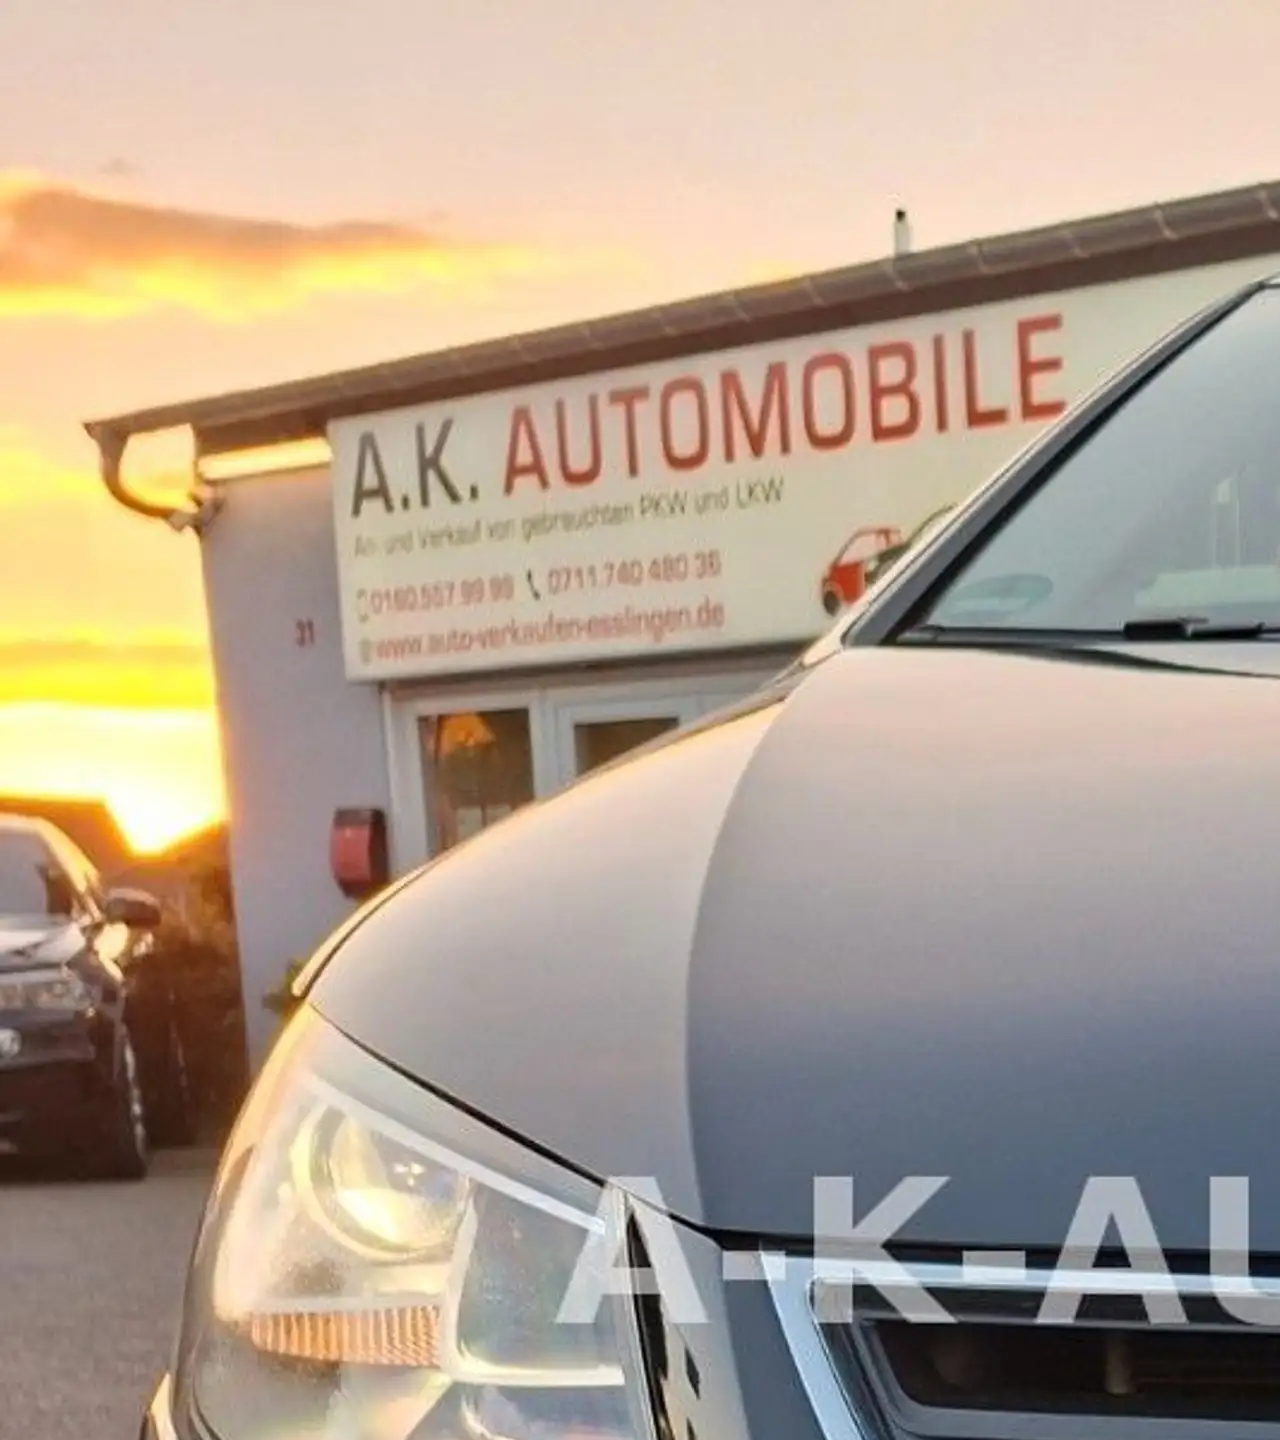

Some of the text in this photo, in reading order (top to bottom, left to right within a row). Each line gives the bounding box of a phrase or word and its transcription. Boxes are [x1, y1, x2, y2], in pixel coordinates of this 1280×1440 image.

[351, 313, 1070, 518] A.K. AUTOMOBILE
[639, 489, 688, 519] PKW
[694, 485, 730, 517] und
[736, 474, 785, 510] LKW
